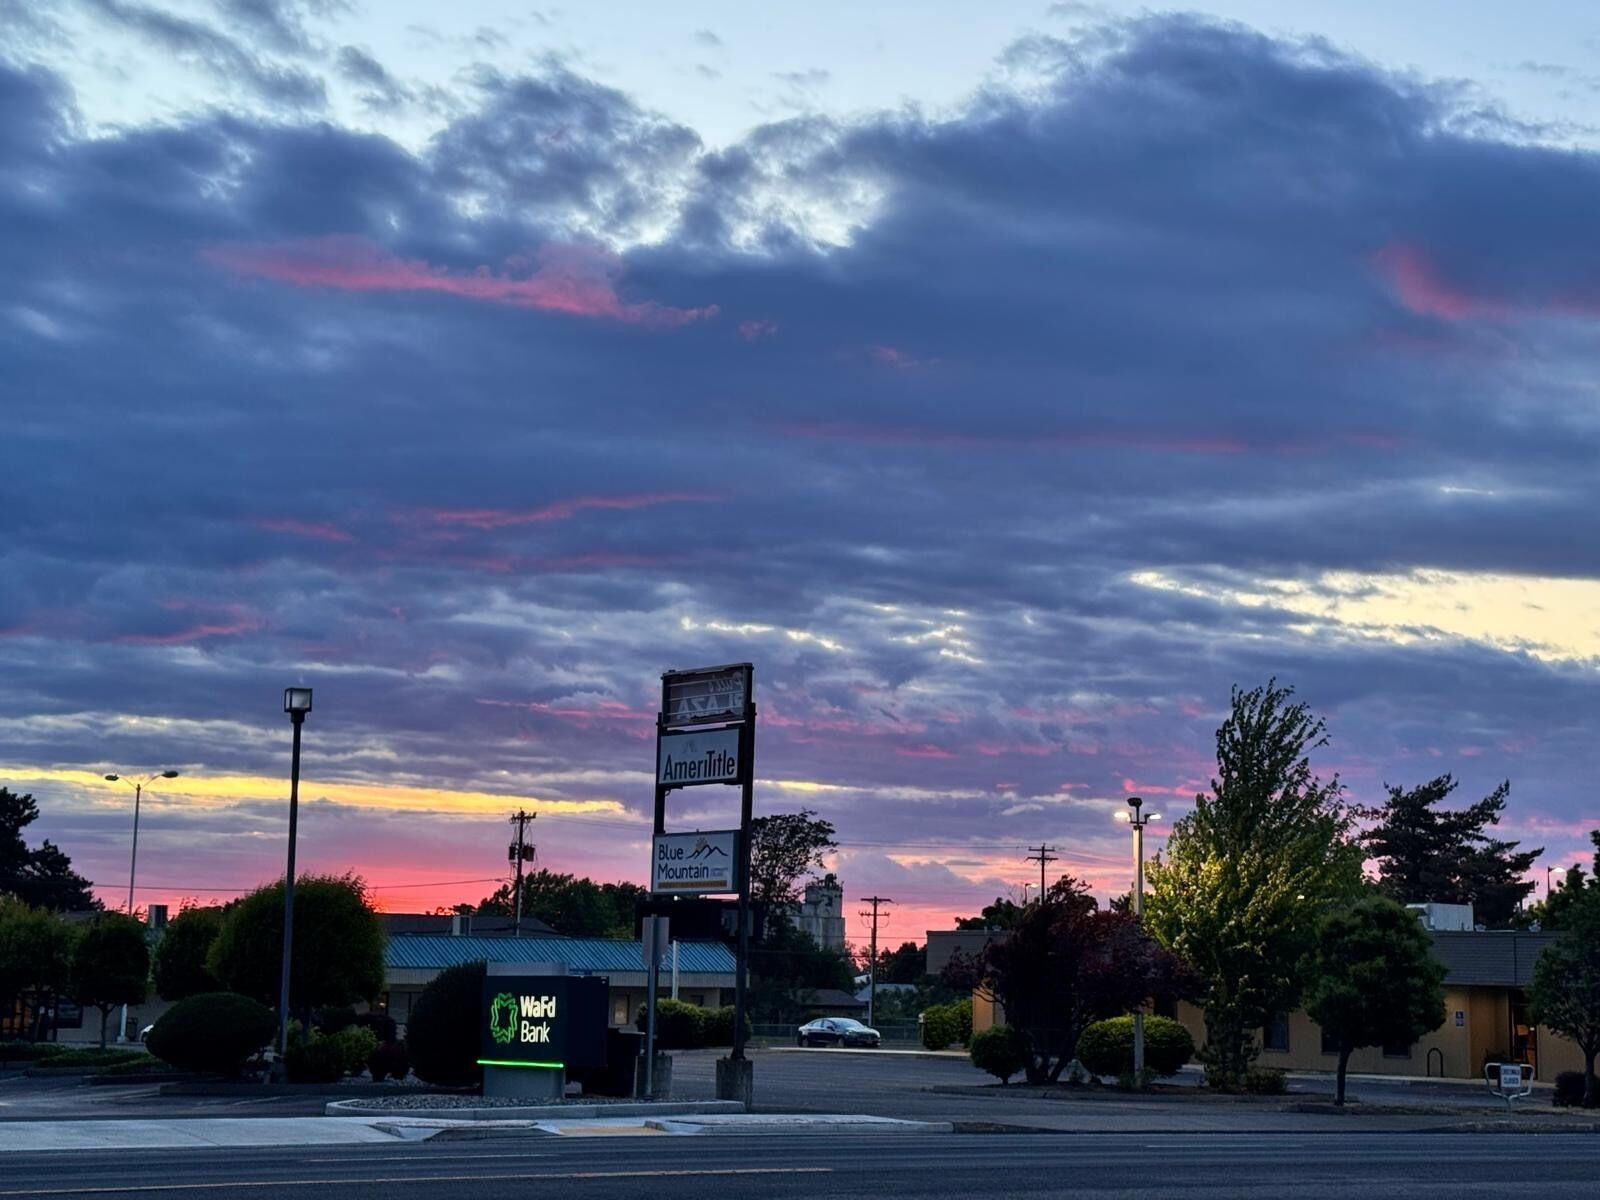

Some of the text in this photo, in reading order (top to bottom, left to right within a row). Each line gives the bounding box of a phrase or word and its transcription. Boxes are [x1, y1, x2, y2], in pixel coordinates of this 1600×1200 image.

[663, 749, 735, 780] AmeriTitle
[658, 844, 684, 861] Blue
[658, 862, 709, 880] Mountain
[520, 996, 556, 1018] WaFd
[520, 1020, 550, 1043] Bank
